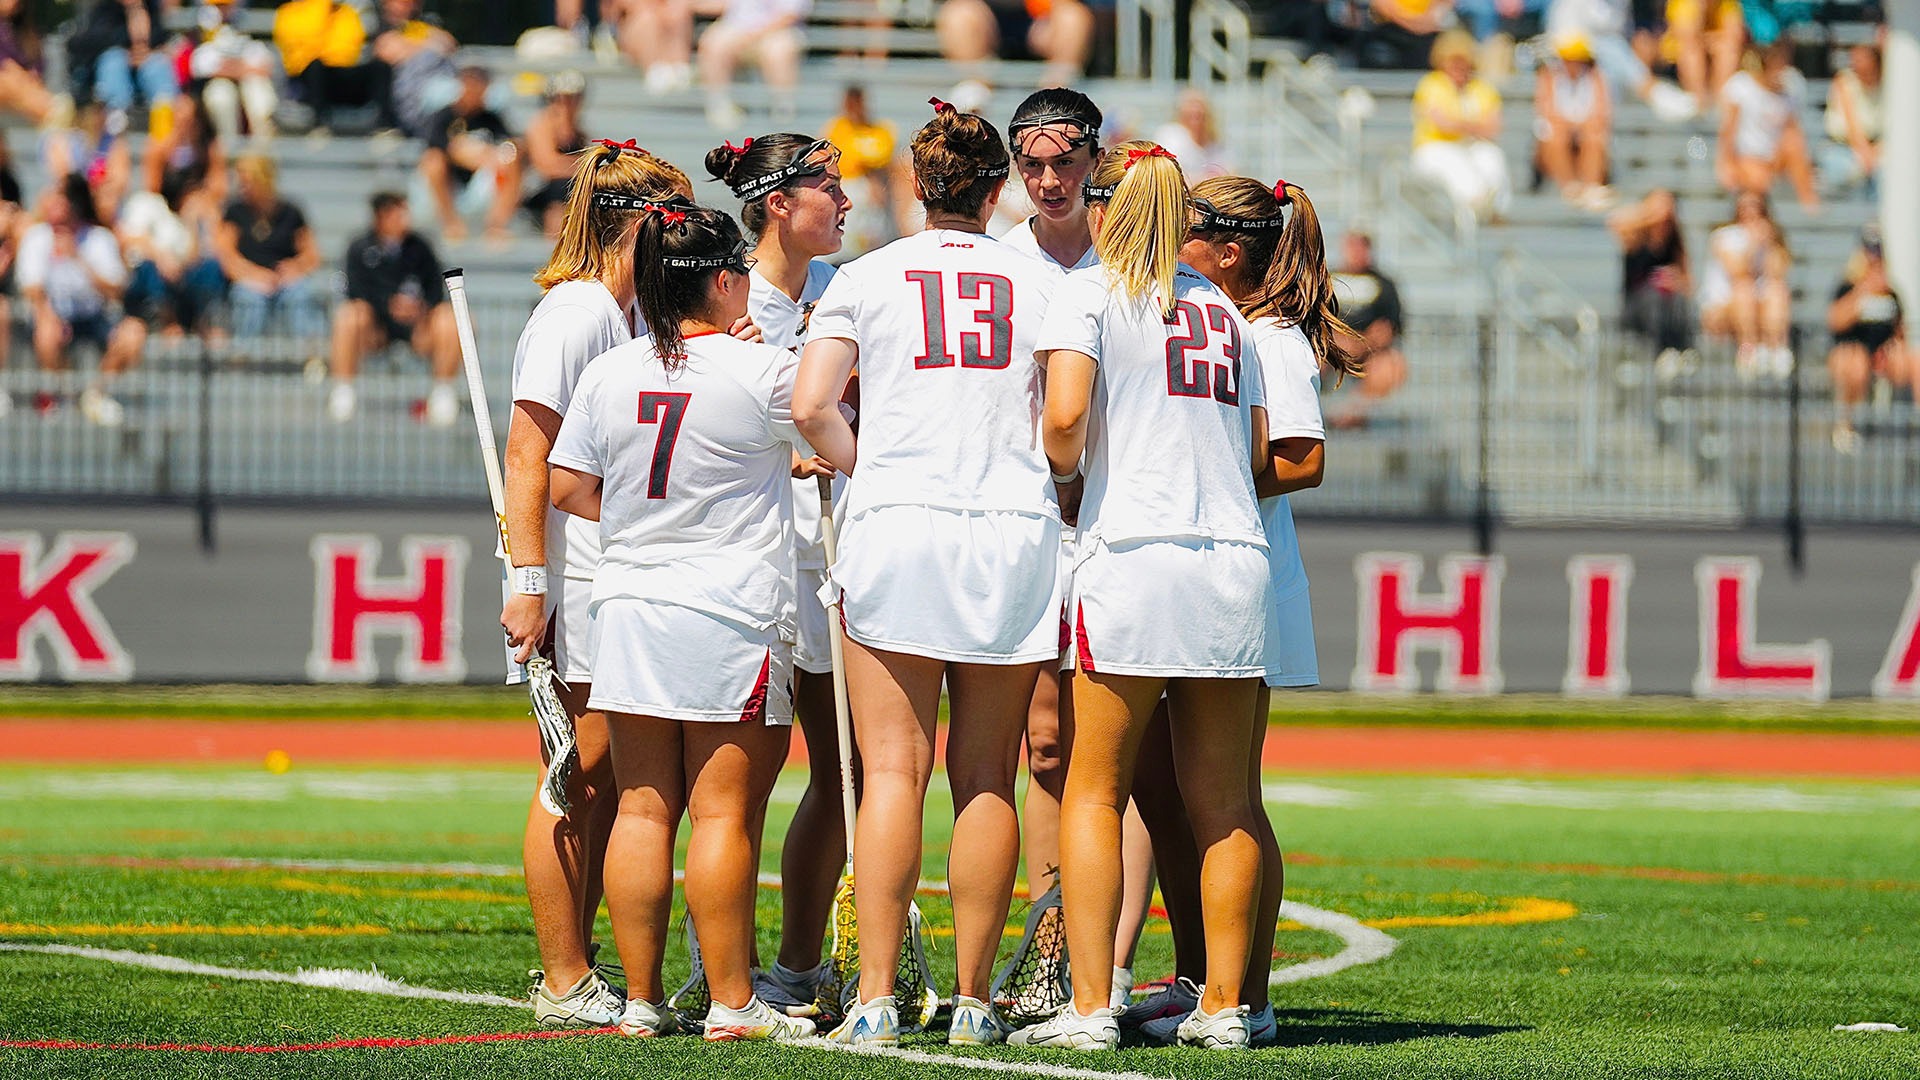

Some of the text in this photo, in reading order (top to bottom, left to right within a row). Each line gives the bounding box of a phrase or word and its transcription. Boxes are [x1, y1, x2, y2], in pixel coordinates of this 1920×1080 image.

[759, 170, 783, 185] GAIT
[671, 259, 697, 268] GAIT
[699, 258, 723, 267] GAIT
[905, 270, 1013, 370] 13
[1157, 296, 1241, 407] 23
[637, 391, 692, 499] 7
